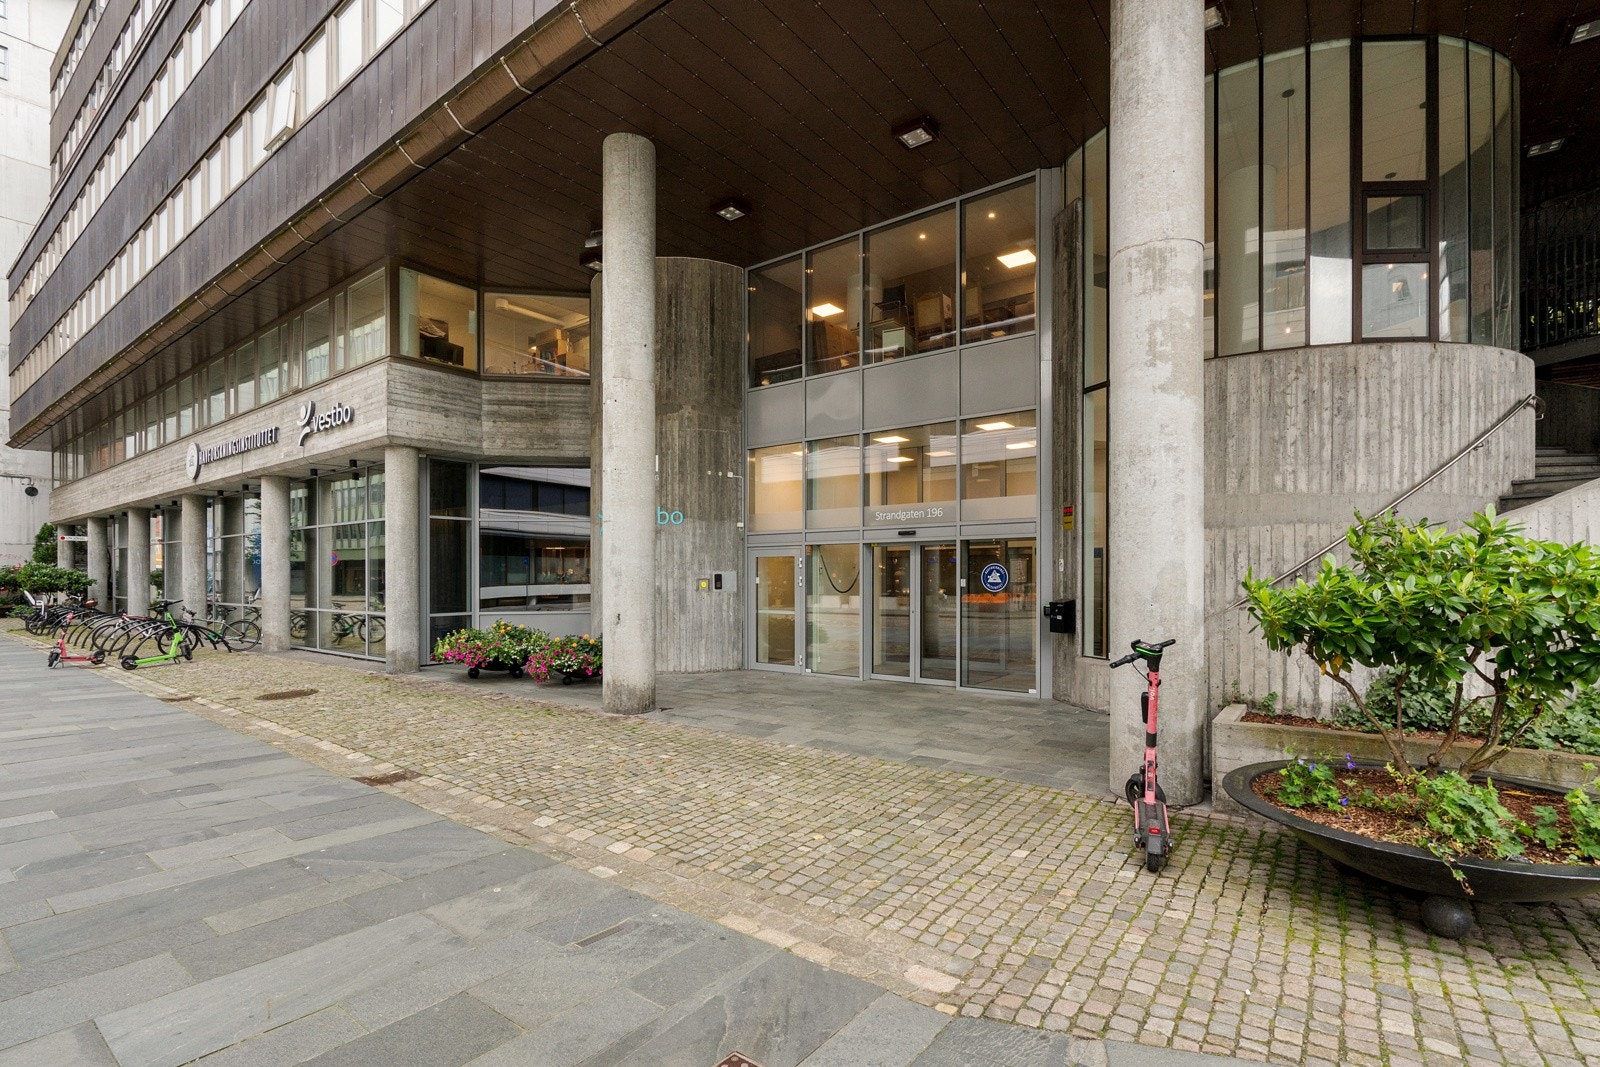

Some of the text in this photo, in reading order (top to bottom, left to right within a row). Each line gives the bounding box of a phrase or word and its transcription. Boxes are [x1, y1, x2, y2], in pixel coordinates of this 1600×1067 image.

[312, 404, 352, 432] vestbo
[875, 507, 944, 521] Strandgaten 196
